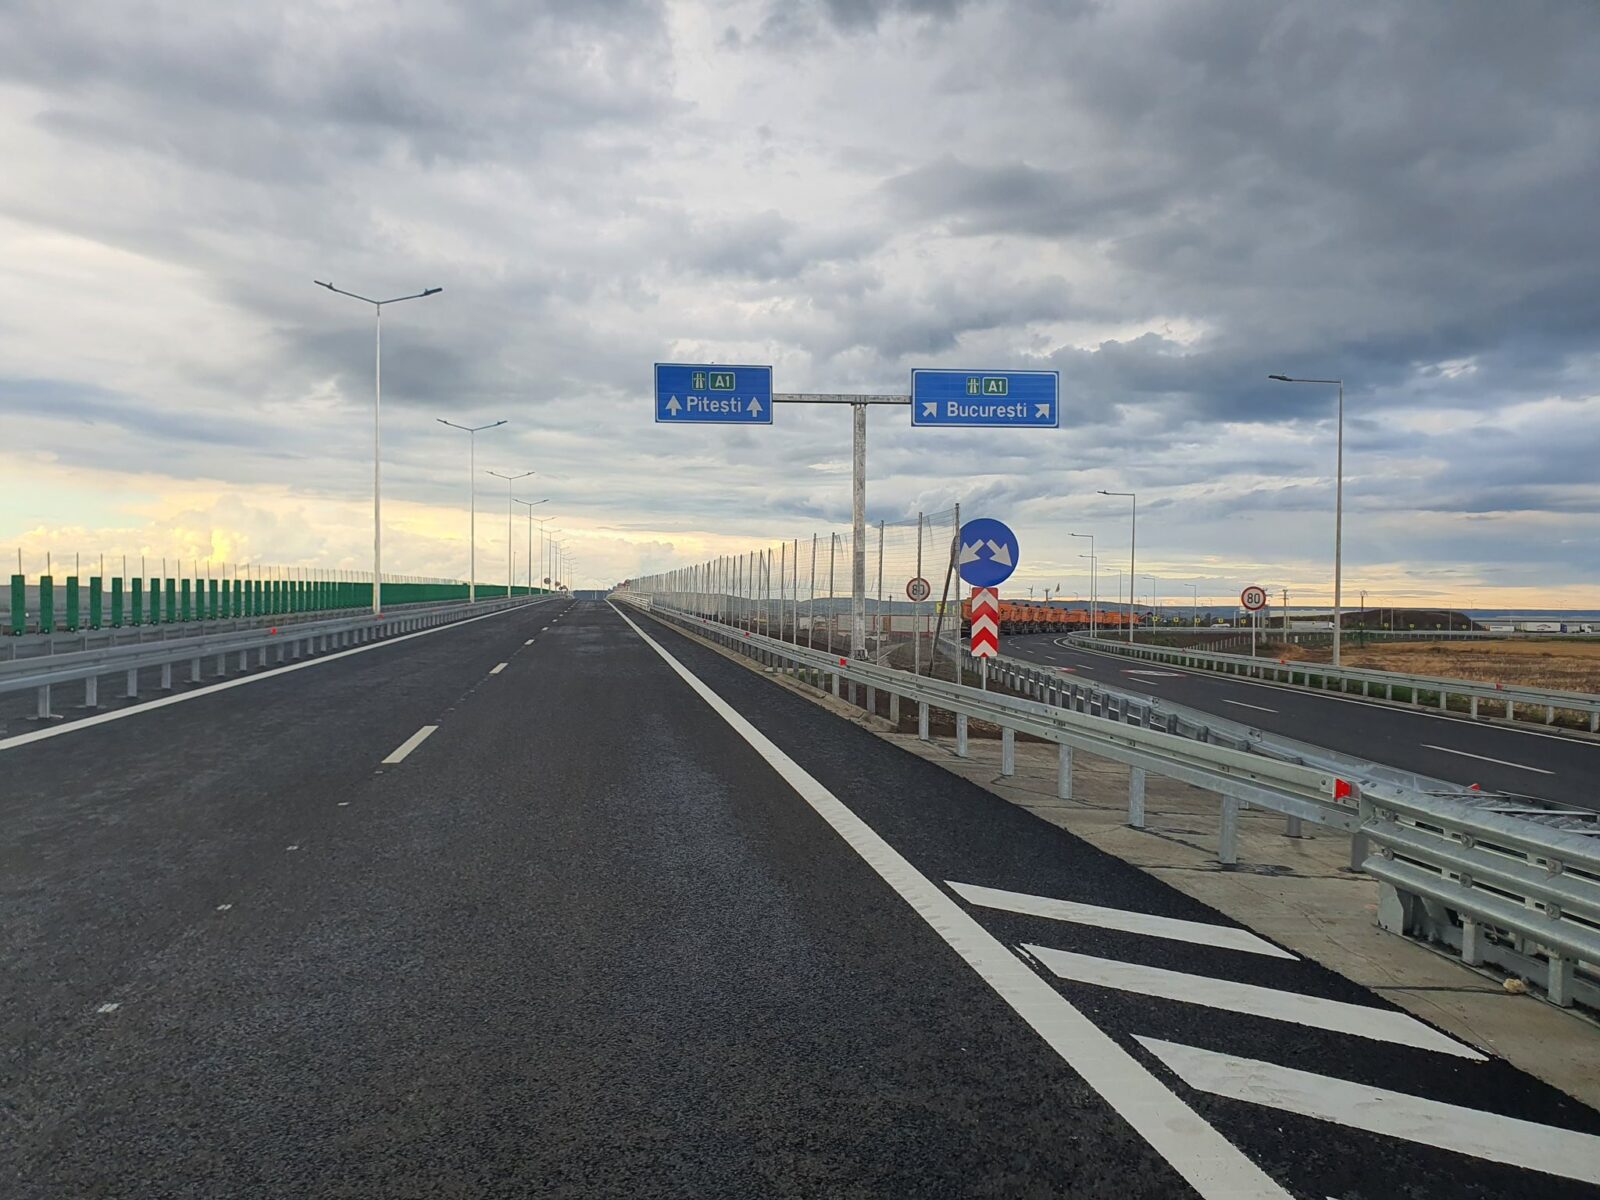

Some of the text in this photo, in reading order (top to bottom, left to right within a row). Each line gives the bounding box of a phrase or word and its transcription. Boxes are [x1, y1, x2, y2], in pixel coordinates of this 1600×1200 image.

[715, 375, 730, 388] A1
[988, 380, 1003, 393] A1
[686, 395, 741, 416] Pitești
[947, 401, 1027, 420] București
[1247, 592, 1261, 605] 80
